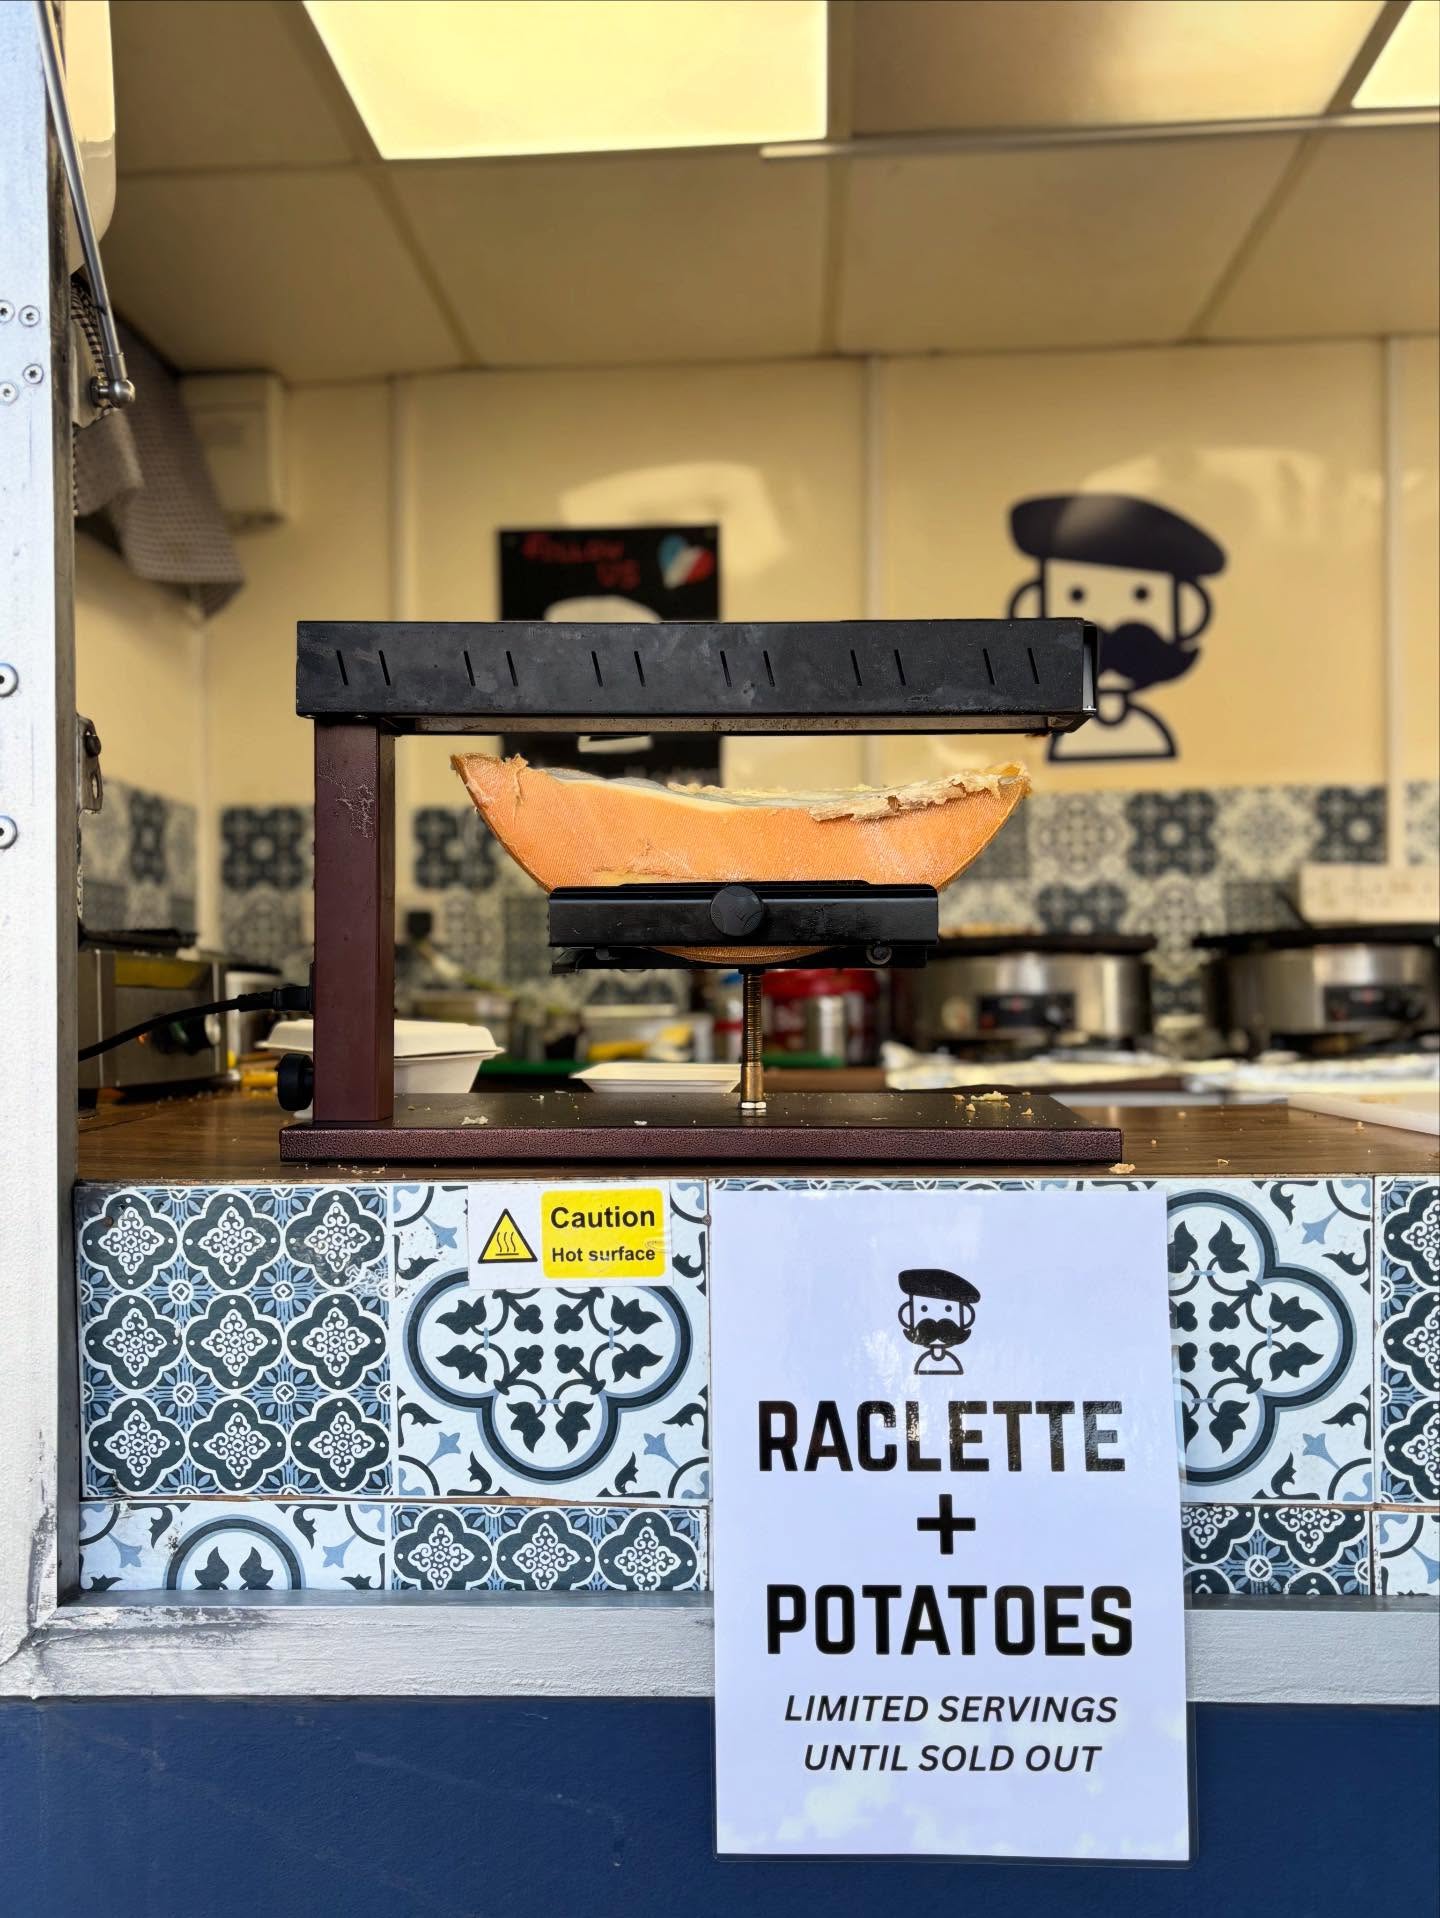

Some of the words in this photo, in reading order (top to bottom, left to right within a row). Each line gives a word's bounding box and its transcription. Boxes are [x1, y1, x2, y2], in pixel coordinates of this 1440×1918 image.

[550, 1205, 655, 1229] Caution
[551, 1247, 584, 1262] Hot
[588, 1245, 656, 1262] surface
[758, 1400, 1126, 1472] RACLETTE
[917, 1494, 976, 1555] +
[766, 1584, 1133, 1657] POTATOES
[785, 1695, 929, 1722] LIMITED
[937, 1696, 1118, 1724] SERVINGS
[804, 1745, 909, 1772] UNTIL
[918, 1744, 1015, 1772] SOLD
[1025, 1745, 1103, 1772] OUT
